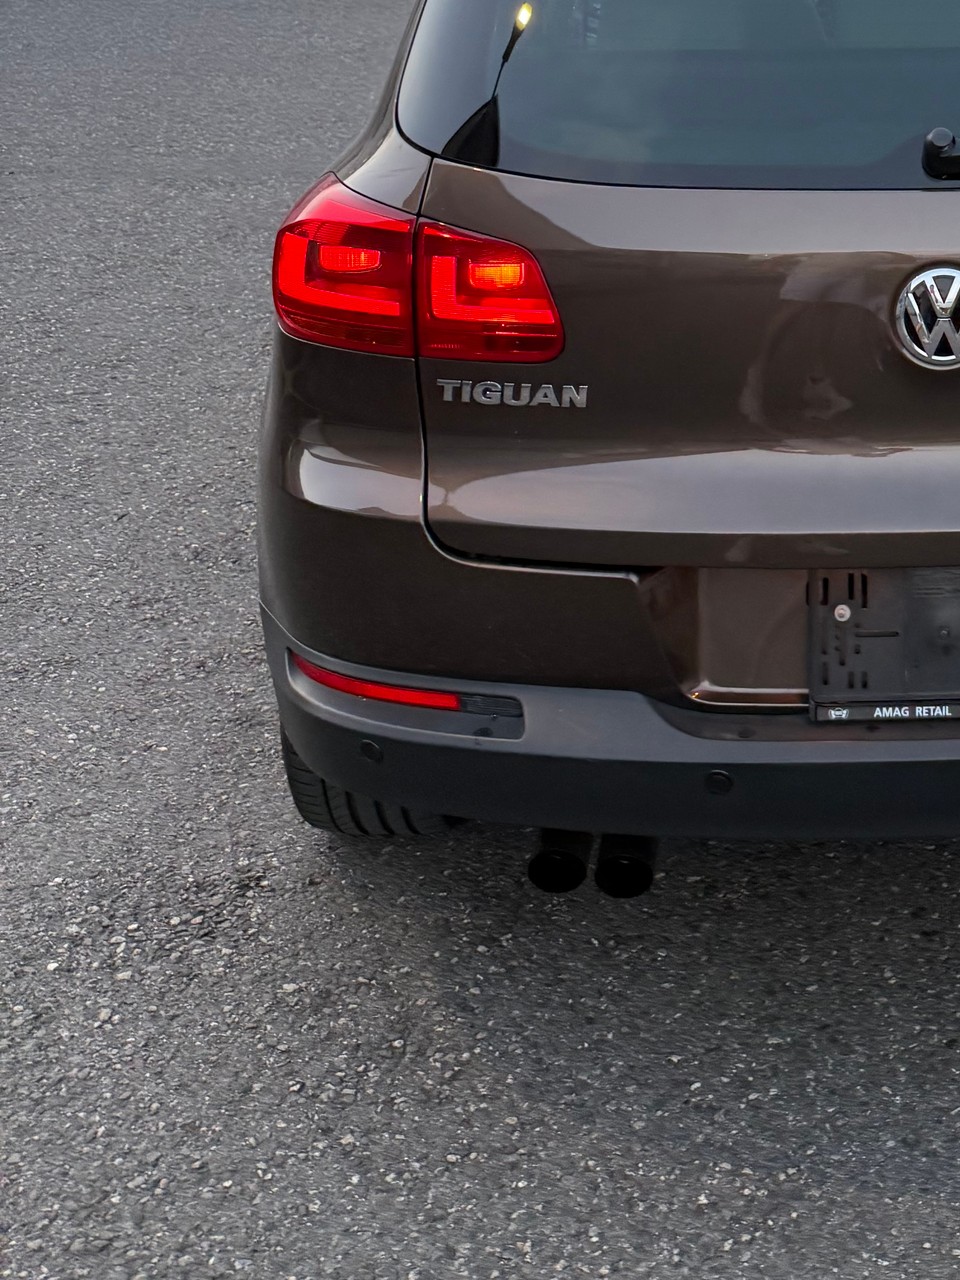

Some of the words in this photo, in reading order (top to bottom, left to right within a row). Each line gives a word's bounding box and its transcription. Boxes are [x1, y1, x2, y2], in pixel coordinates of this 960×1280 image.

[436, 378, 588, 408] TIGUAN
[873, 706, 910, 718] AMAG
[915, 705, 952, 717] RETAIL
